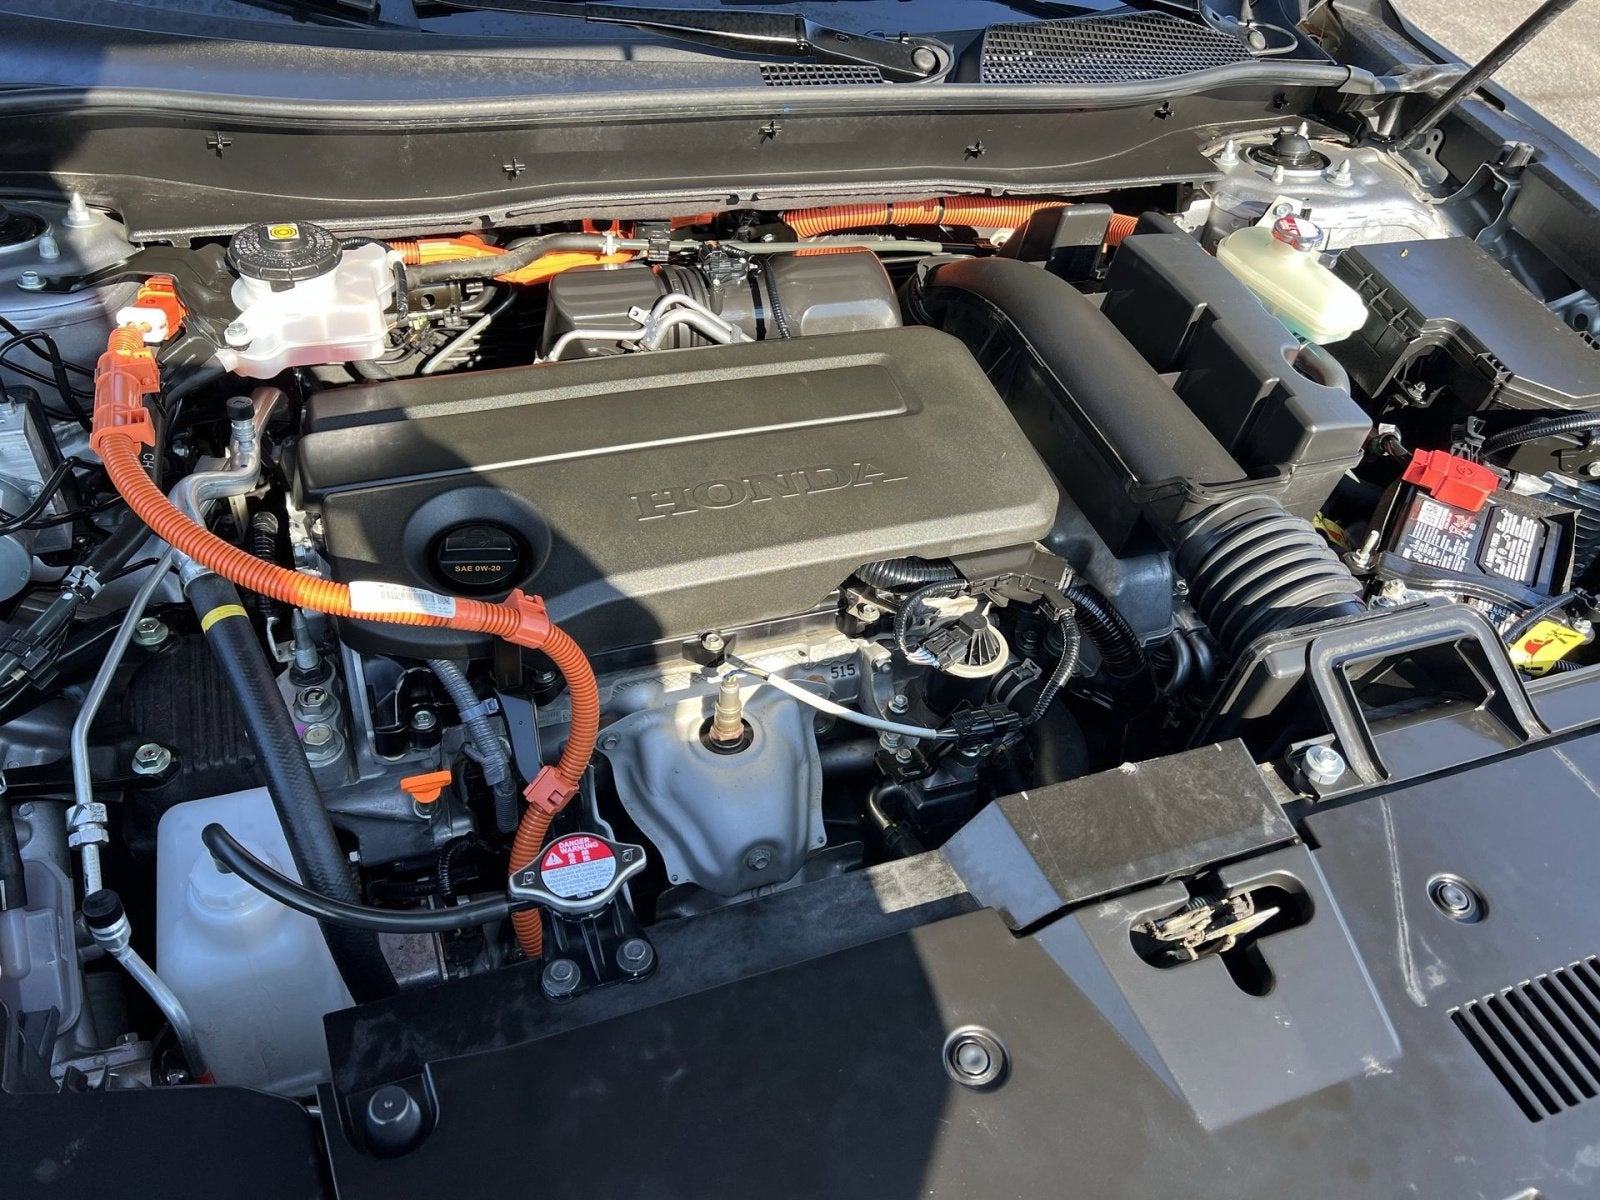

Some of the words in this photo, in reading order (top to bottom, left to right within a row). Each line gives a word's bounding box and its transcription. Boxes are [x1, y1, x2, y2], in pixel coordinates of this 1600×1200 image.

[628, 458, 909, 521] HONDA
[475, 564, 501, 572] 0W-20
[830, 663, 856, 679] 515
[558, 837, 590, 849] DANGER
[560, 841, 599, 854] WARNUNG
